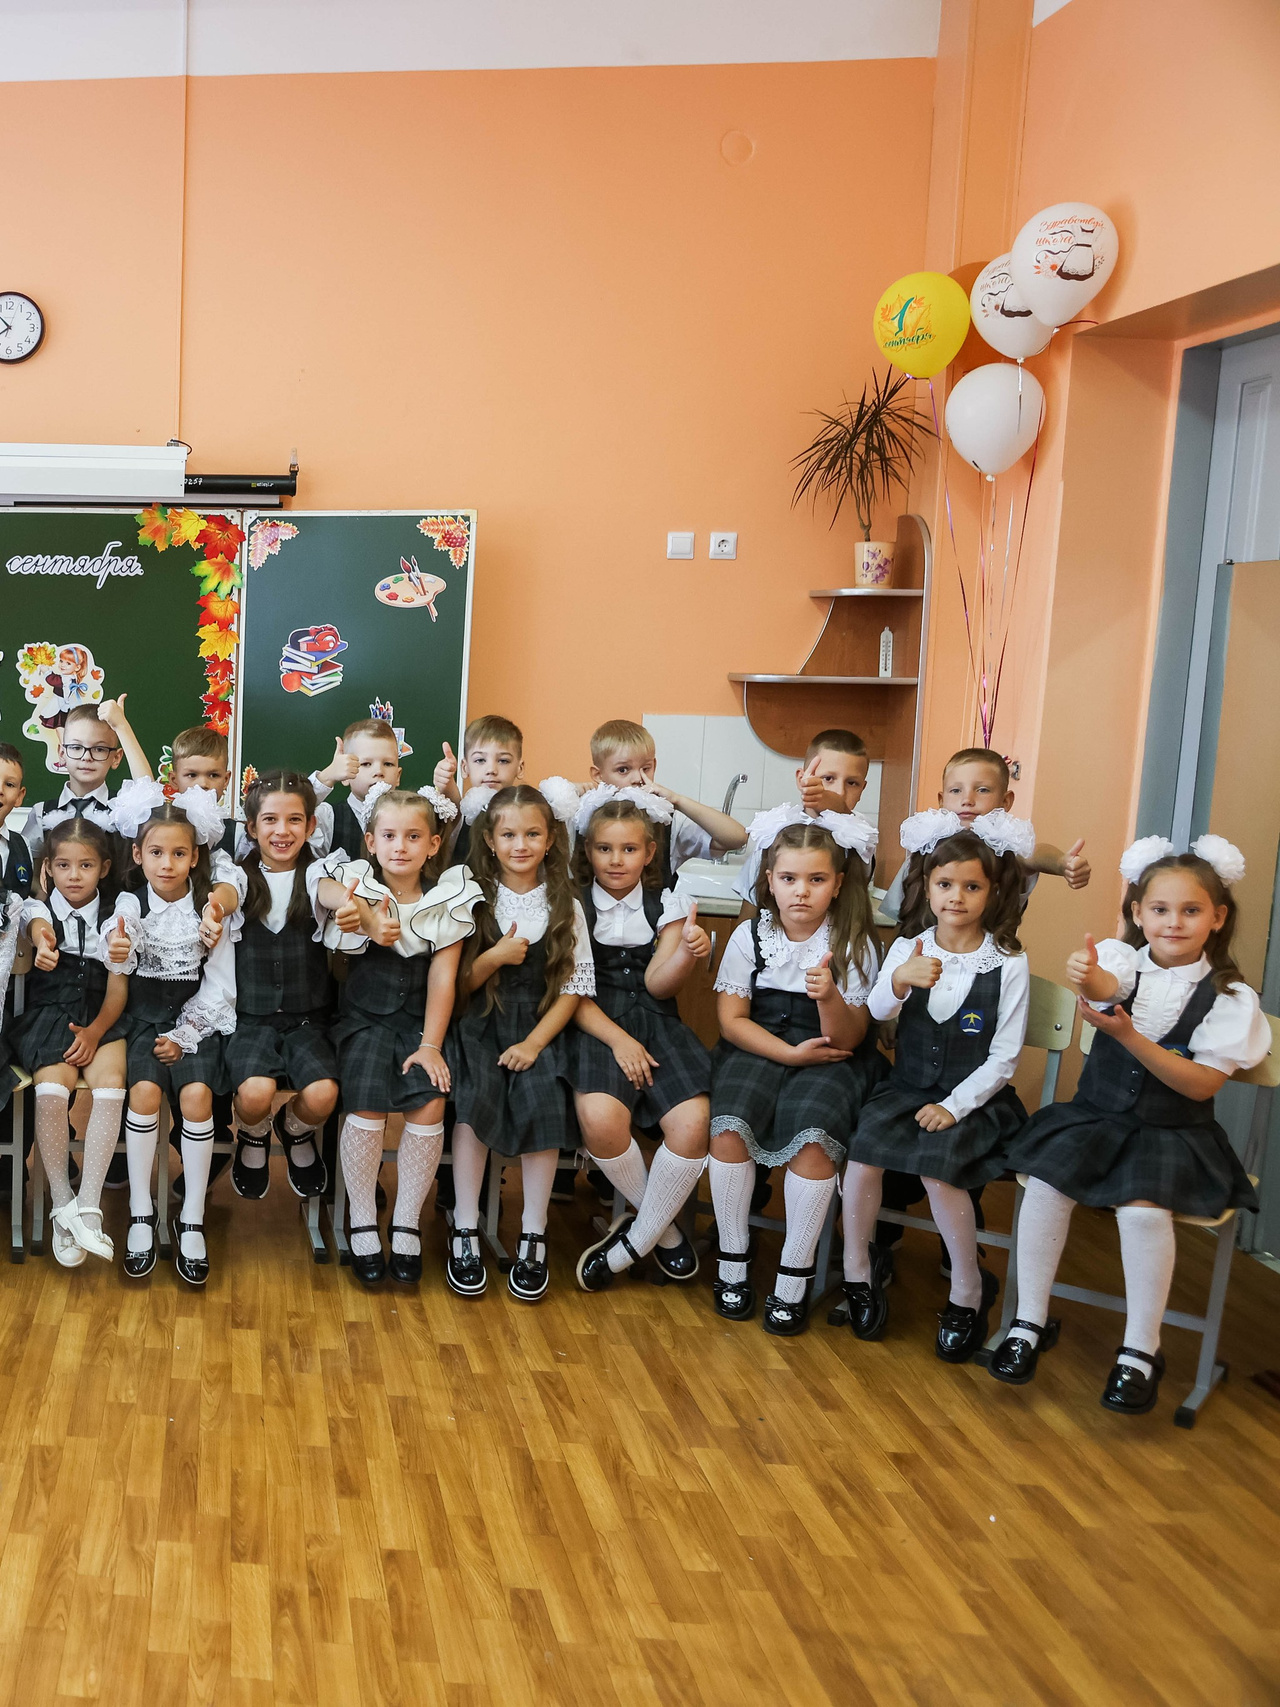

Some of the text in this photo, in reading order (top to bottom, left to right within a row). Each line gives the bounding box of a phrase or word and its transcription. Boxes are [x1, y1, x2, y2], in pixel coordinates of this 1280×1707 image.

[5, 301, 14, 310] 12
[26, 312, 32, 320] 2
[29, 324, 36, 332] 3
[24, 336, 31, 344] 4
[5, 346, 12, 355] 6
[16, 343, 23, 352] 5
